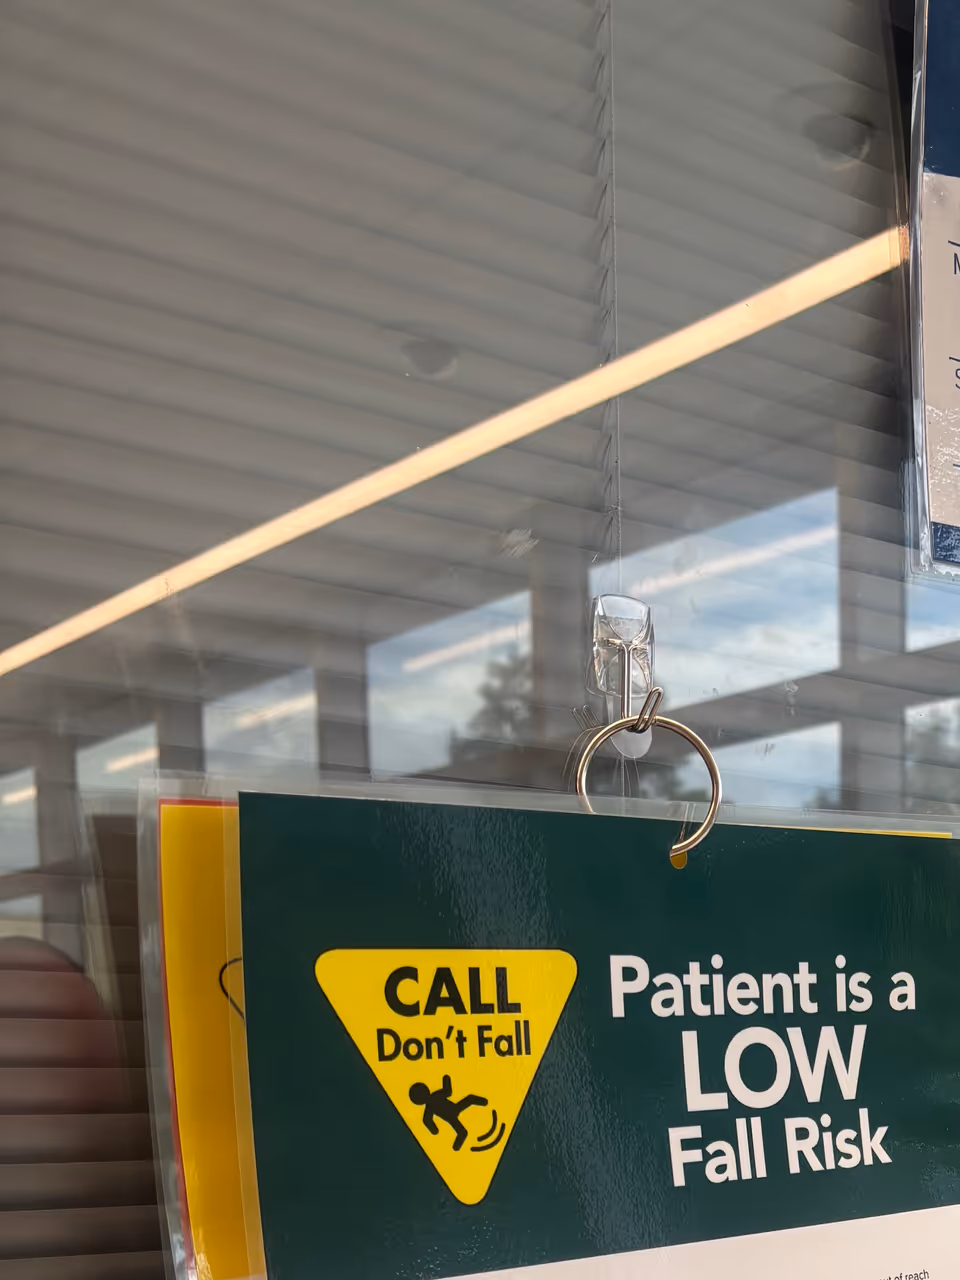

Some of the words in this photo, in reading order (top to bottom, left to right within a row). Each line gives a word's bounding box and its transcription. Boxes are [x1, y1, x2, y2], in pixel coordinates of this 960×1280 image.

[384, 965, 522, 1018] CALL
[609, 954, 818, 1018] Patient
[834, 954, 872, 1012] is
[889, 972, 916, 1011] a
[376, 1024, 469, 1062] Don't
[477, 1020, 531, 1057] Fall
[682, 1024, 867, 1112] LOW
[668, 1116, 767, 1187] Fall
[785, 1107, 892, 1174] Risk
